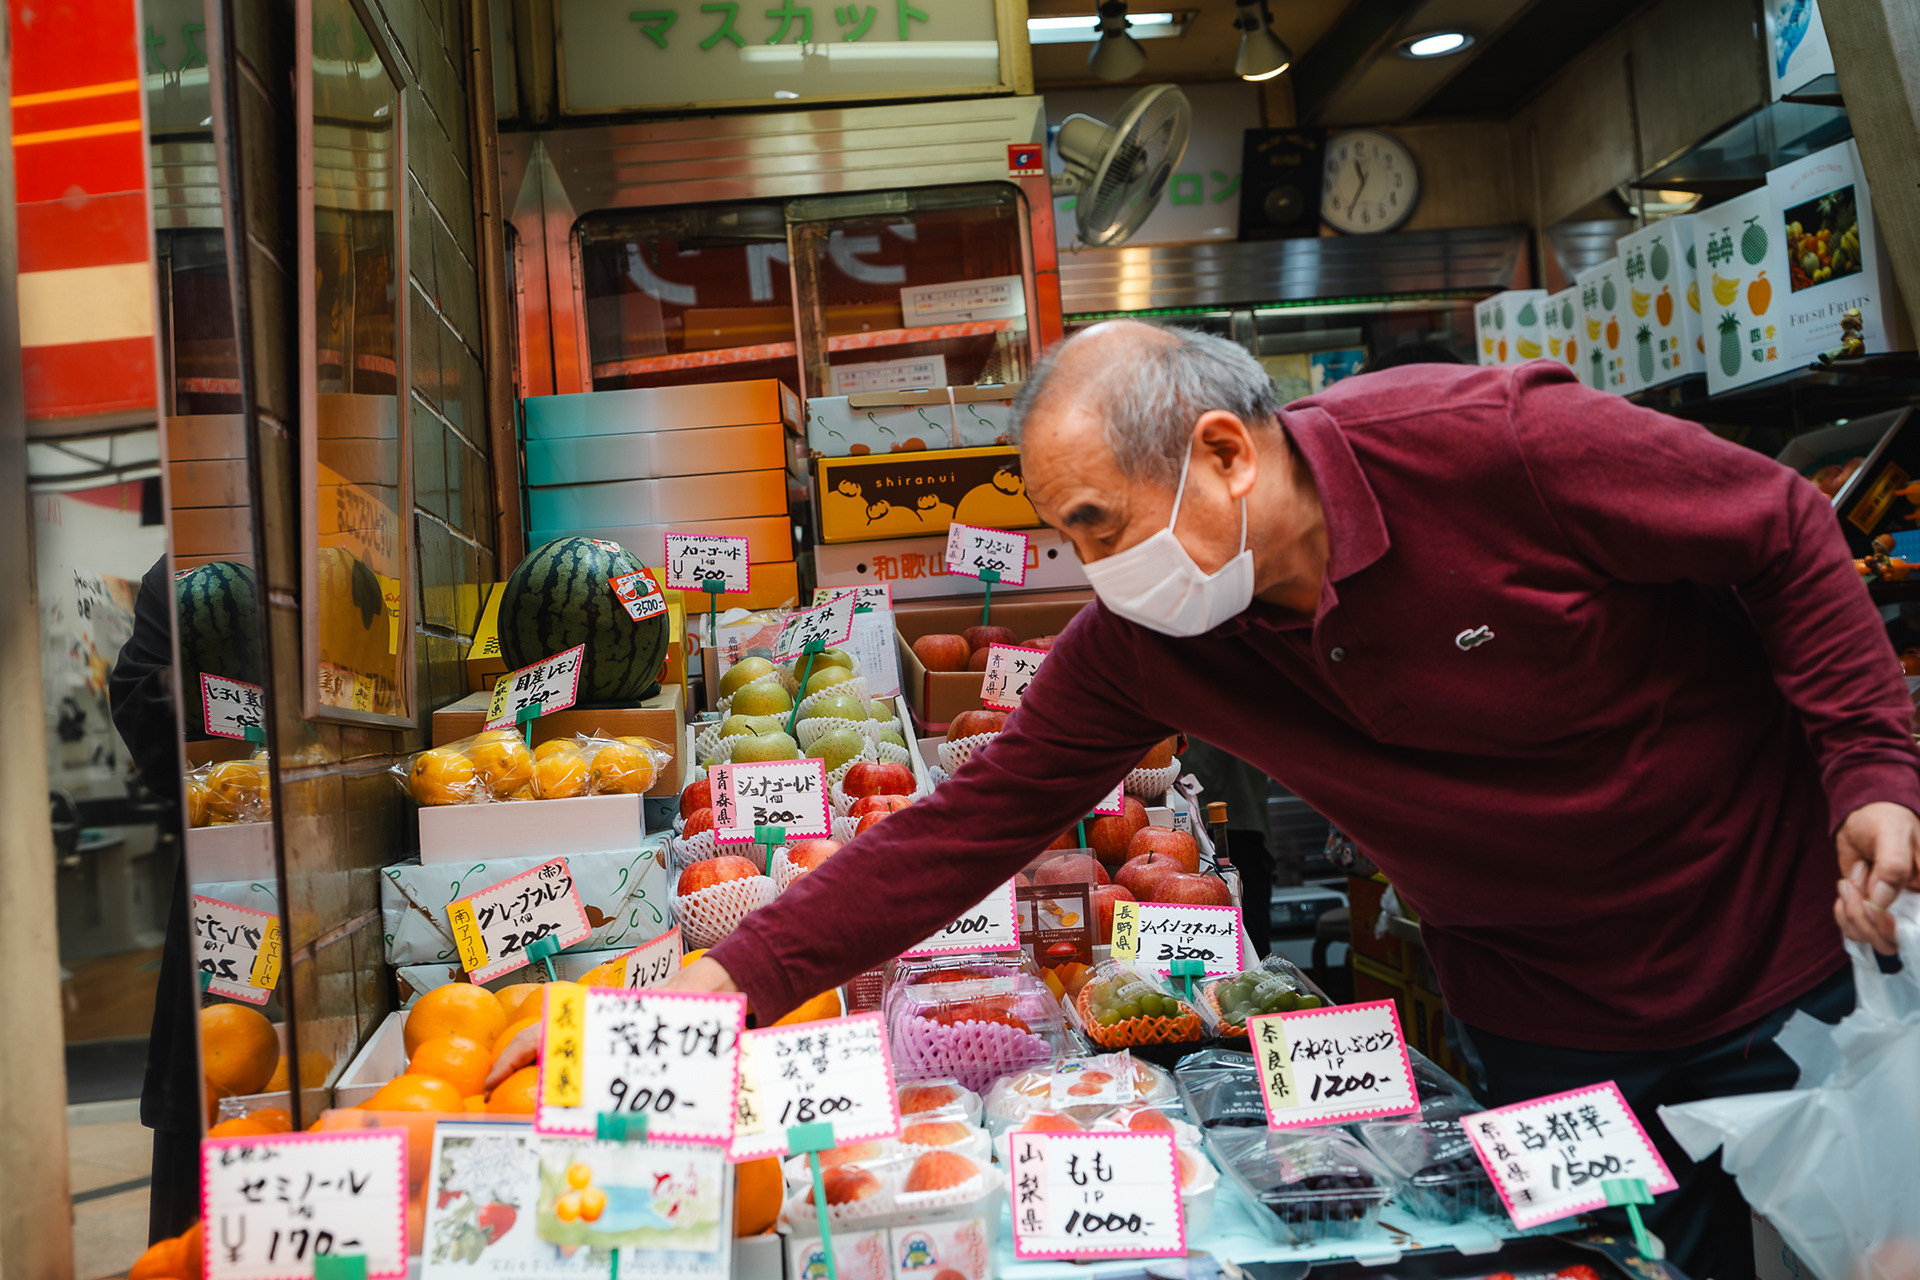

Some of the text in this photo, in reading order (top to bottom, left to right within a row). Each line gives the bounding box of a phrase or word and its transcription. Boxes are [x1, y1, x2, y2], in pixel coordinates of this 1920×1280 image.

[630, 0, 929, 49] マスカット
[1789, 294, 1871, 328] FRESH FRUITS
[875, 471, 956, 489] shiranui
[680, 544, 741, 561] メローゴールド
[974, 535, 1015, 554] サンふじ
[801, 607, 835, 630] 王林
[514, 654, 578, 692] 国産レモン
[986, 653, 1004, 696] 青森県
[716, 769, 733, 825] 青森県
[737, 774, 816, 797] ジョナゴールド
[765, 794, 784, 804] 1個
[478, 876, 573, 931] グレープフルーツ
[512, 912, 534, 927] 1個
[454, 908, 479, 968] 南アフリカ
[1115, 904, 1135, 951] 長野県
[1139, 918, 1237, 936] シャインマスカット
[630, 948, 674, 991] オレンジ
[1262, 1020, 1290, 1099] 奈良県
[240, 1167, 371, 1203] セミノール
[1067, 1151, 1113, 1186] もも
[1018, 1142, 1044, 1233] 山梨県
[1084, 1190, 1104, 1204] 1P
